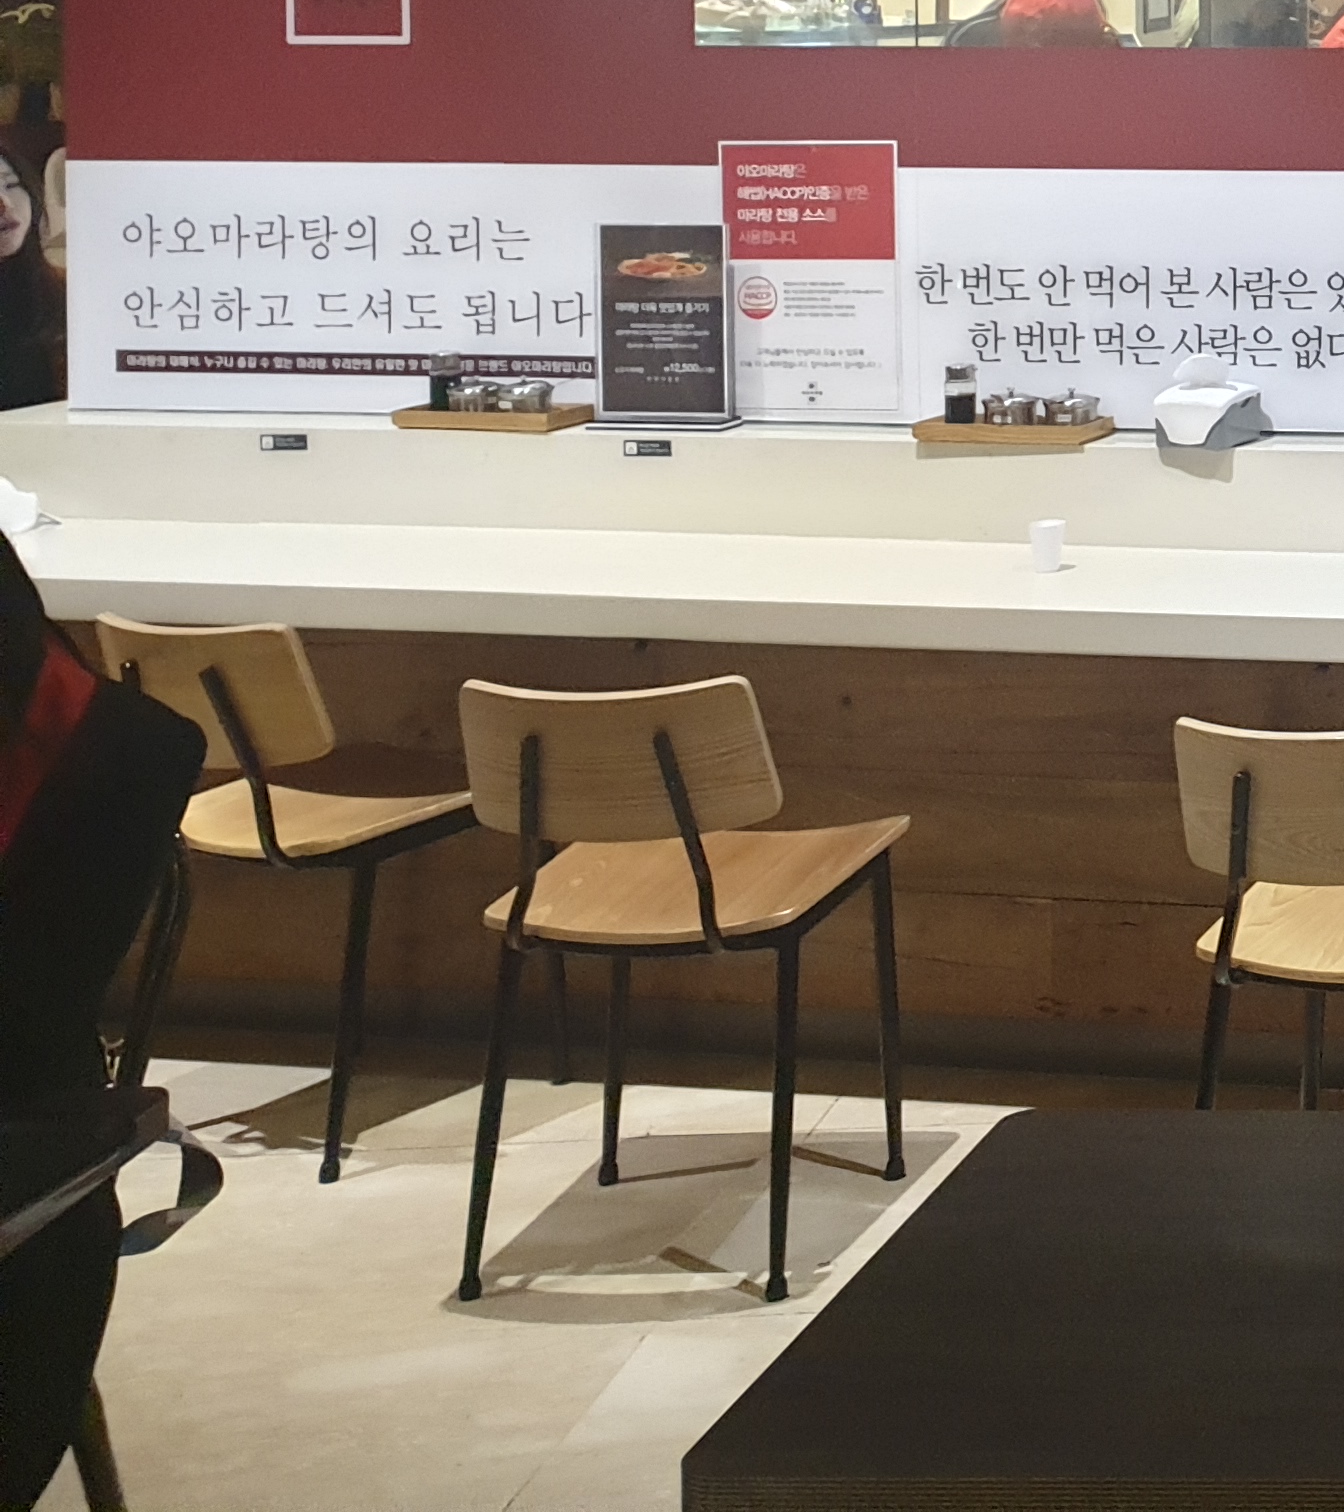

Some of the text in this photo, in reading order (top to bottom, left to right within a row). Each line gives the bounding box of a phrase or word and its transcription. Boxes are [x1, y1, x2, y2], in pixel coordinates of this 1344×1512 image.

[123, 213, 531, 262] 야오마라탕의 요리는
[916, 263, 953, 305] 한
[960, 264, 1031, 306] 번도
[1038, 264, 1074, 308] 안
[1083, 266, 1151, 309] 먹어
[1160, 267, 1200, 309] 본
[1207, 267, 1318, 311] 사람은
[124, 286, 294, 332] 안심하고
[315, 288, 443, 335] 드셔도
[462, 290, 592, 338] 됩니다
[968, 320, 1006, 363] 한
[1014, 321, 1085, 364] 번만
[1095, 322, 1165, 366] 먹은
[1171, 323, 1282, 366] 사람은
